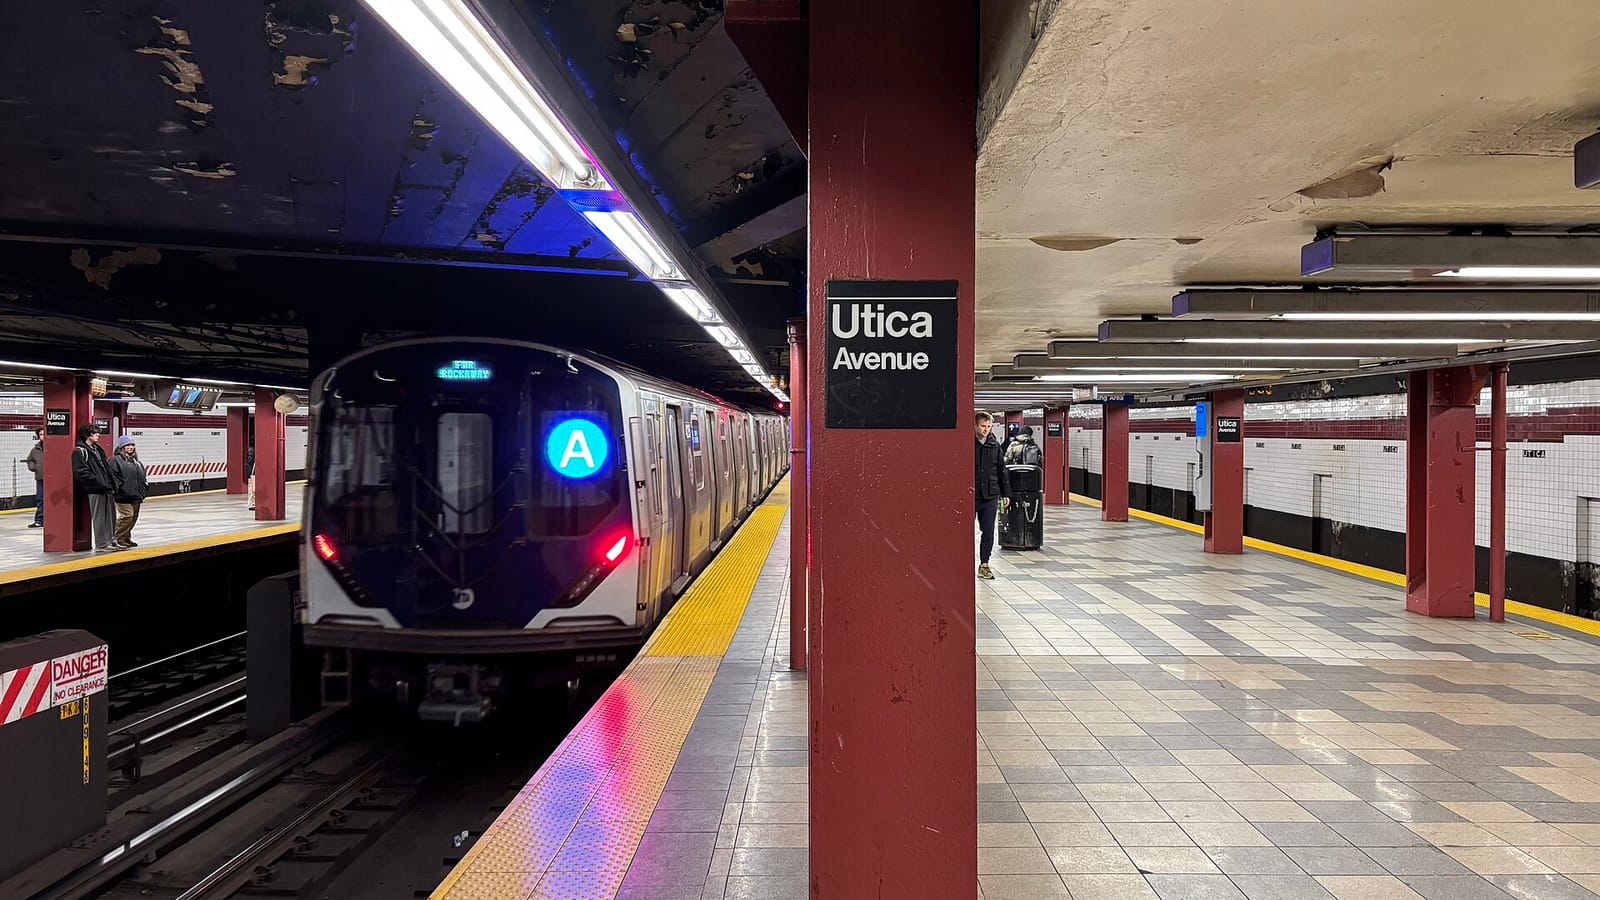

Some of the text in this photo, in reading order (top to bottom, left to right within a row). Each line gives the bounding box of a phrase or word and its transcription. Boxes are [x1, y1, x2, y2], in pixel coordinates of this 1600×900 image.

[832, 303, 933, 339] Utica
[453, 360, 475, 369] FAR
[832, 346, 929, 370] Avenue
[438, 369, 489, 378] ROCKAWAY
[47, 411, 66, 421] Utica
[1218, 419, 1237, 427] Utica
[559, 429, 595, 468] A
[1522, 449, 1546, 458] UTICA
[53, 650, 107, 681] DANGER
[55, 677, 105, 700] NO CLEARANCE
